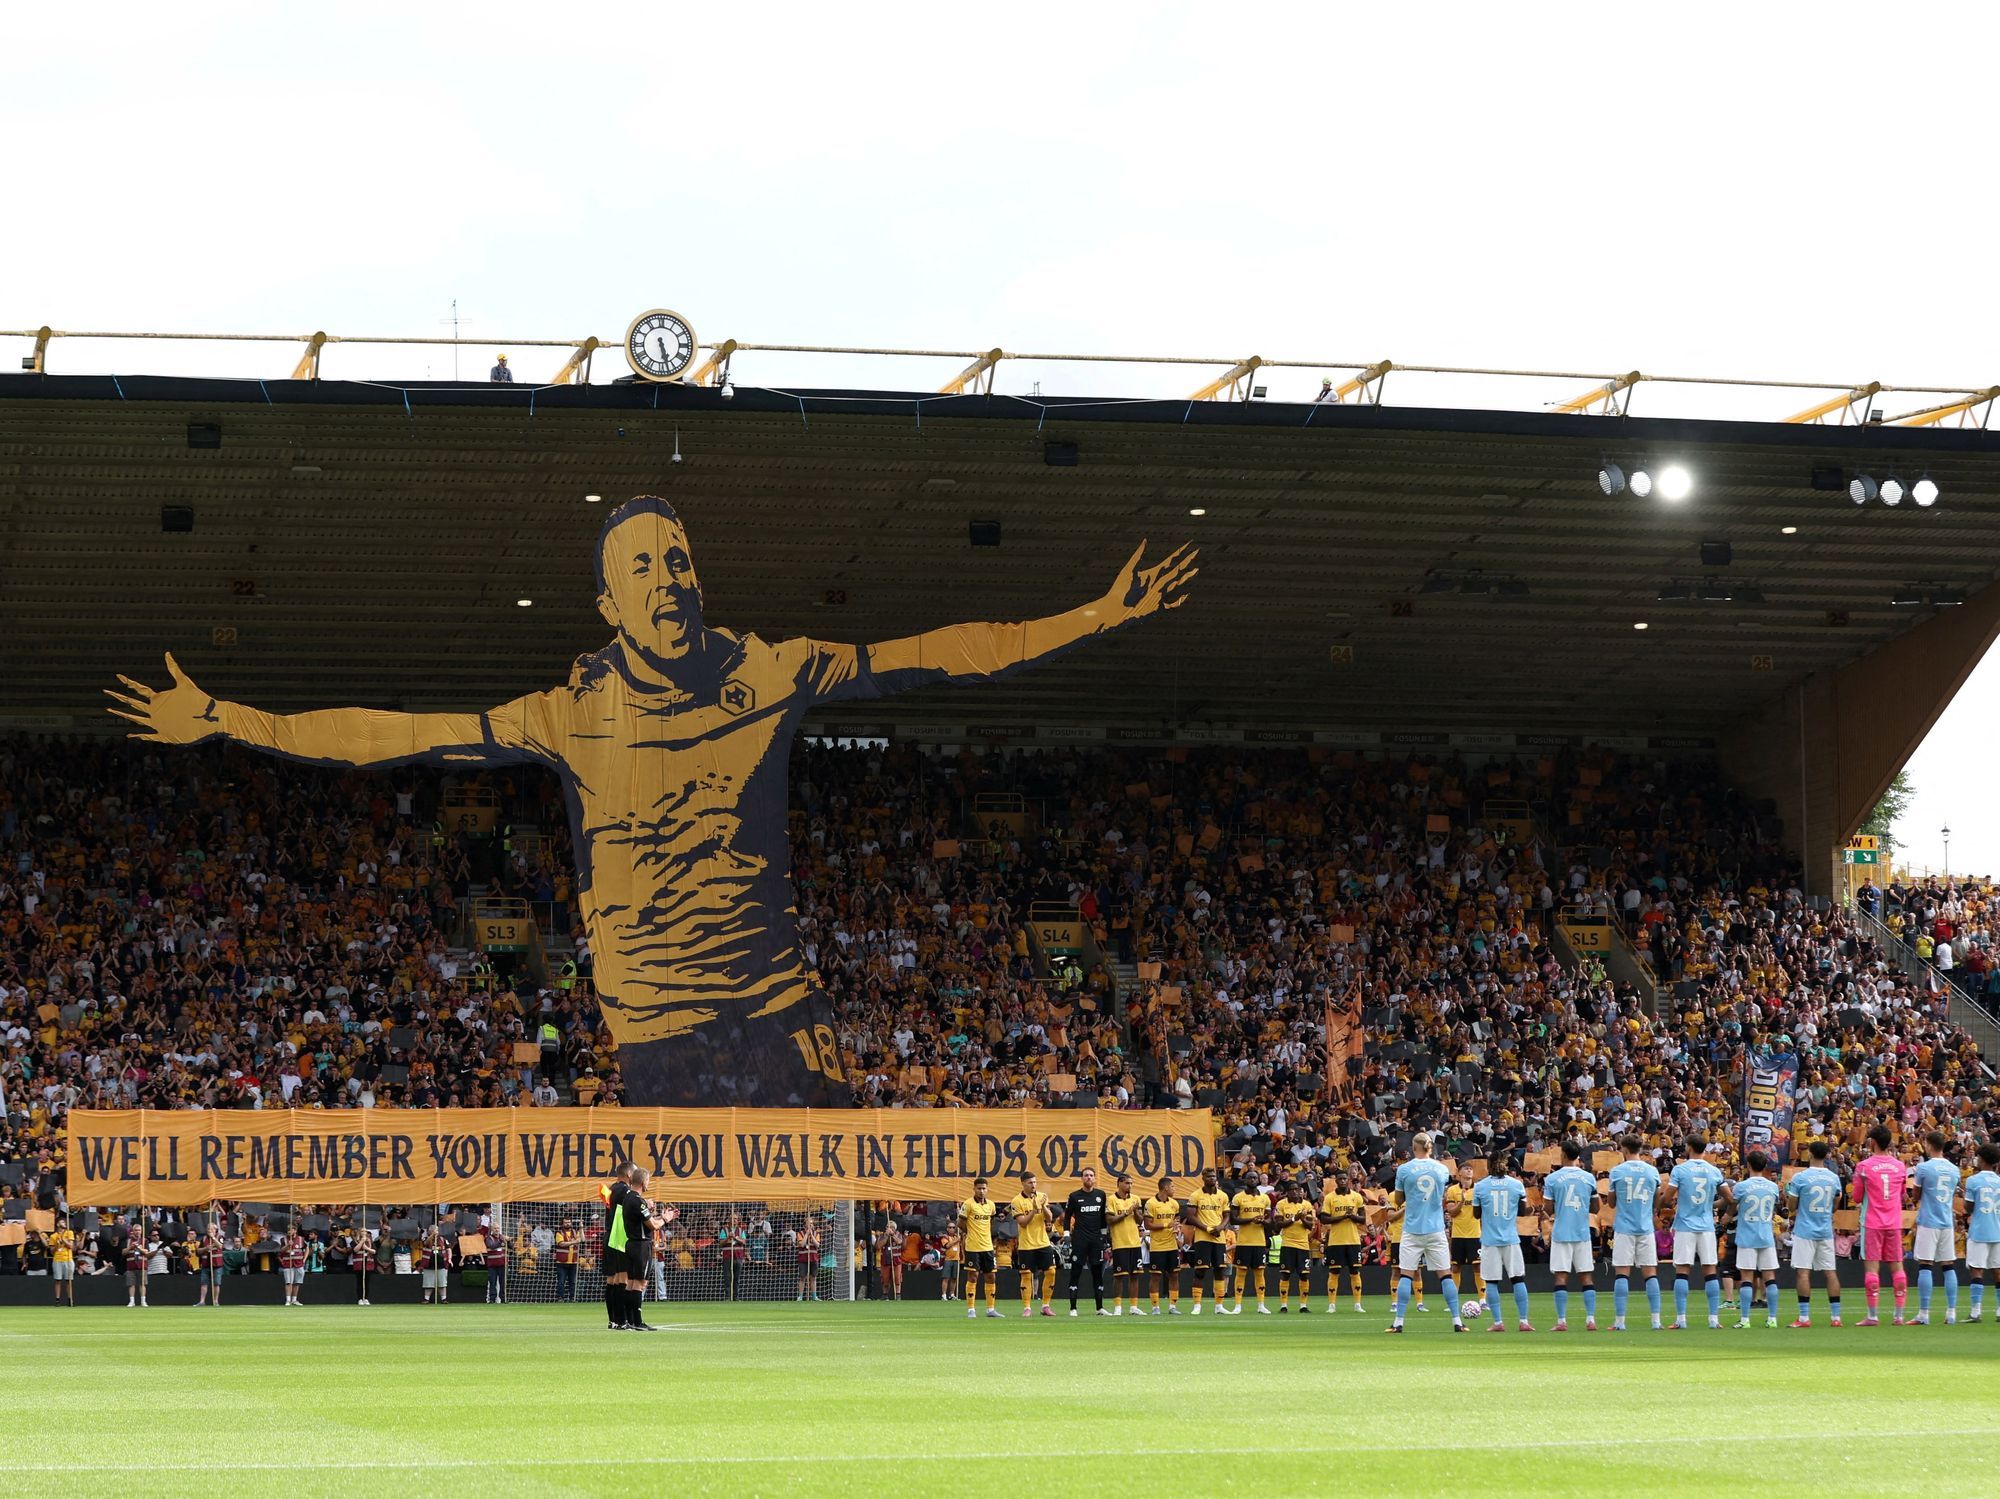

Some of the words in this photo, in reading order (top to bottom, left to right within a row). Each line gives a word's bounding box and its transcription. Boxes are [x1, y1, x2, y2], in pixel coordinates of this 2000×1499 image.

[234, 581, 255, 595] 22
[826, 590, 846, 604] 23
[1392, 603, 1412, 617] 24
[215, 629, 235, 643] 22
[1332, 648, 1351, 661] 24
[1754, 656, 1772, 671] 25
[1868, 838, 1873, 847] 1
[487, 926, 515, 939] SL3
[1043, 929, 1070, 942] SL4
[1572, 933, 1598, 945] SL5
[788, 1023, 847, 1082] 18
[77, 1136, 189, 1181] WE'LL
[200, 1134, 415, 1180] REMEMBER
[426, 1133, 508, 1178] YOU
[520, 1133, 635, 1178] WHEN
[645, 1133, 725, 1178] YOU
[737, 1133, 846, 1178] WALK
[856, 1133, 894, 1178] IN
[903, 1133, 1026, 1178] FIELDS
[1037, 1134, 1090, 1178] OF
[1099, 1133, 1205, 1178] GOLD
[1416, 1175, 1435, 1202] 9
[1564, 1183, 1582, 1211] 4
[1624, 1177, 1649, 1204] 14
[1690, 1177, 1707, 1204] 3
[1880, 1174, 1889, 1200] 1
[1936, 1175, 1951, 1203] 5
[1080, 1205, 1101, 1213] DEBET
[1490, 1190, 1508, 1216] 11
[1744, 1194, 1776, 1222] 20
[1808, 1185, 1833, 1213] 21
